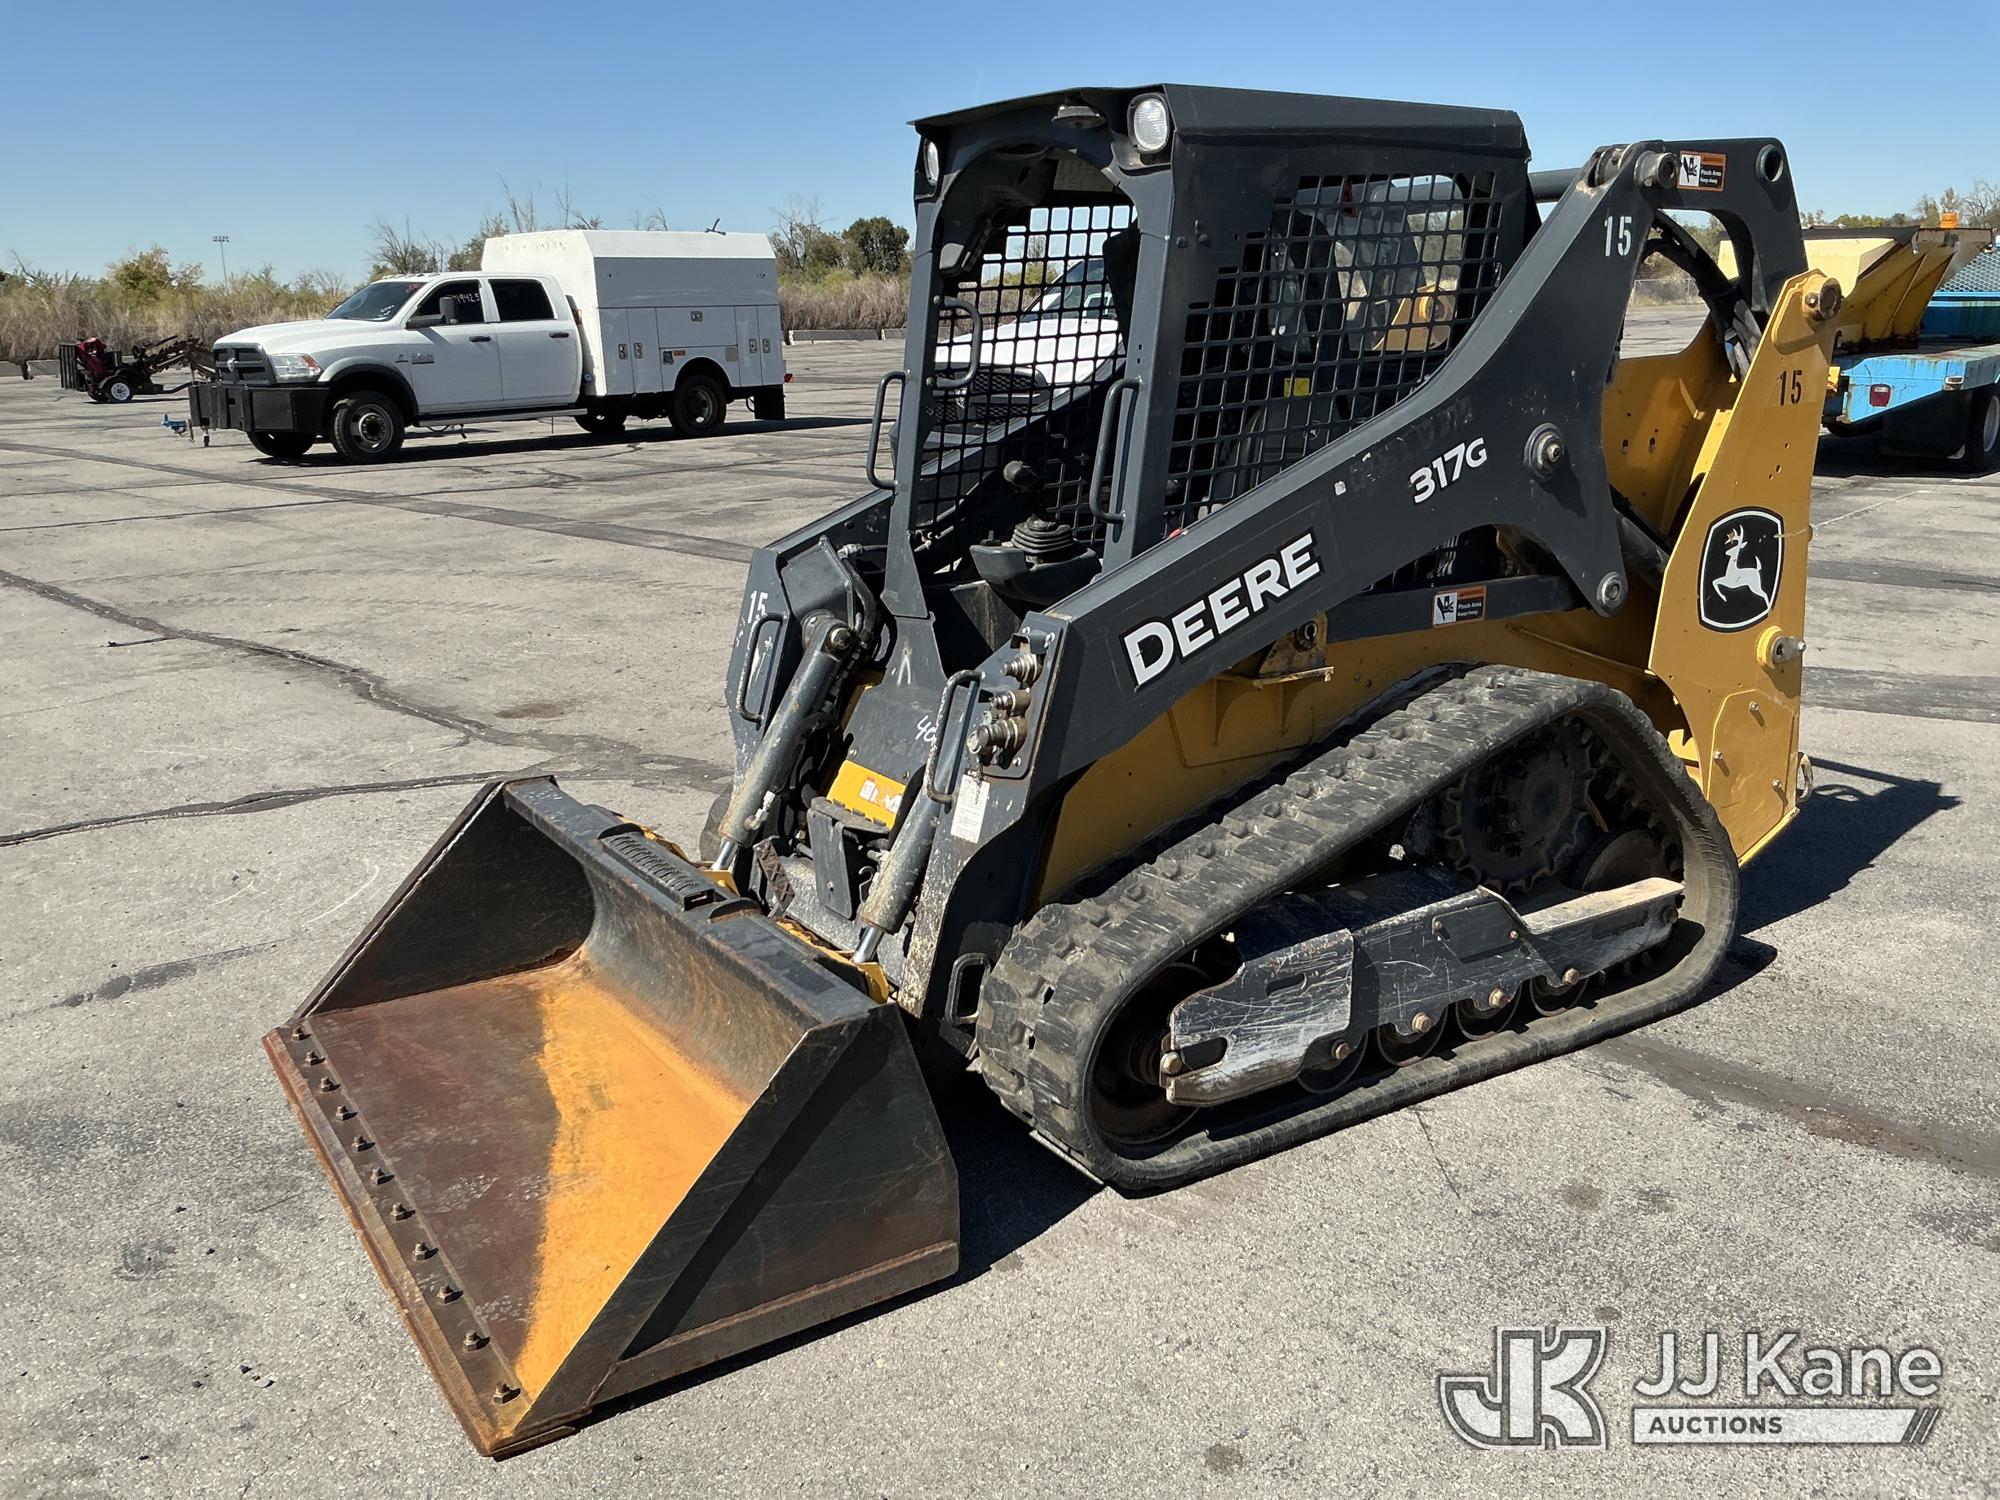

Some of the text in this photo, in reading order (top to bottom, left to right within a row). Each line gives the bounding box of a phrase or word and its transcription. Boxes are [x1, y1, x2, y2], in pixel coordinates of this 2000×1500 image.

[1604, 216, 1632, 257] 15
[1777, 370, 1803, 406] 15
[1409, 437, 1488, 504] 317G
[747, 590, 769, 624] 15
[1123, 532, 1322, 686] DEERE
